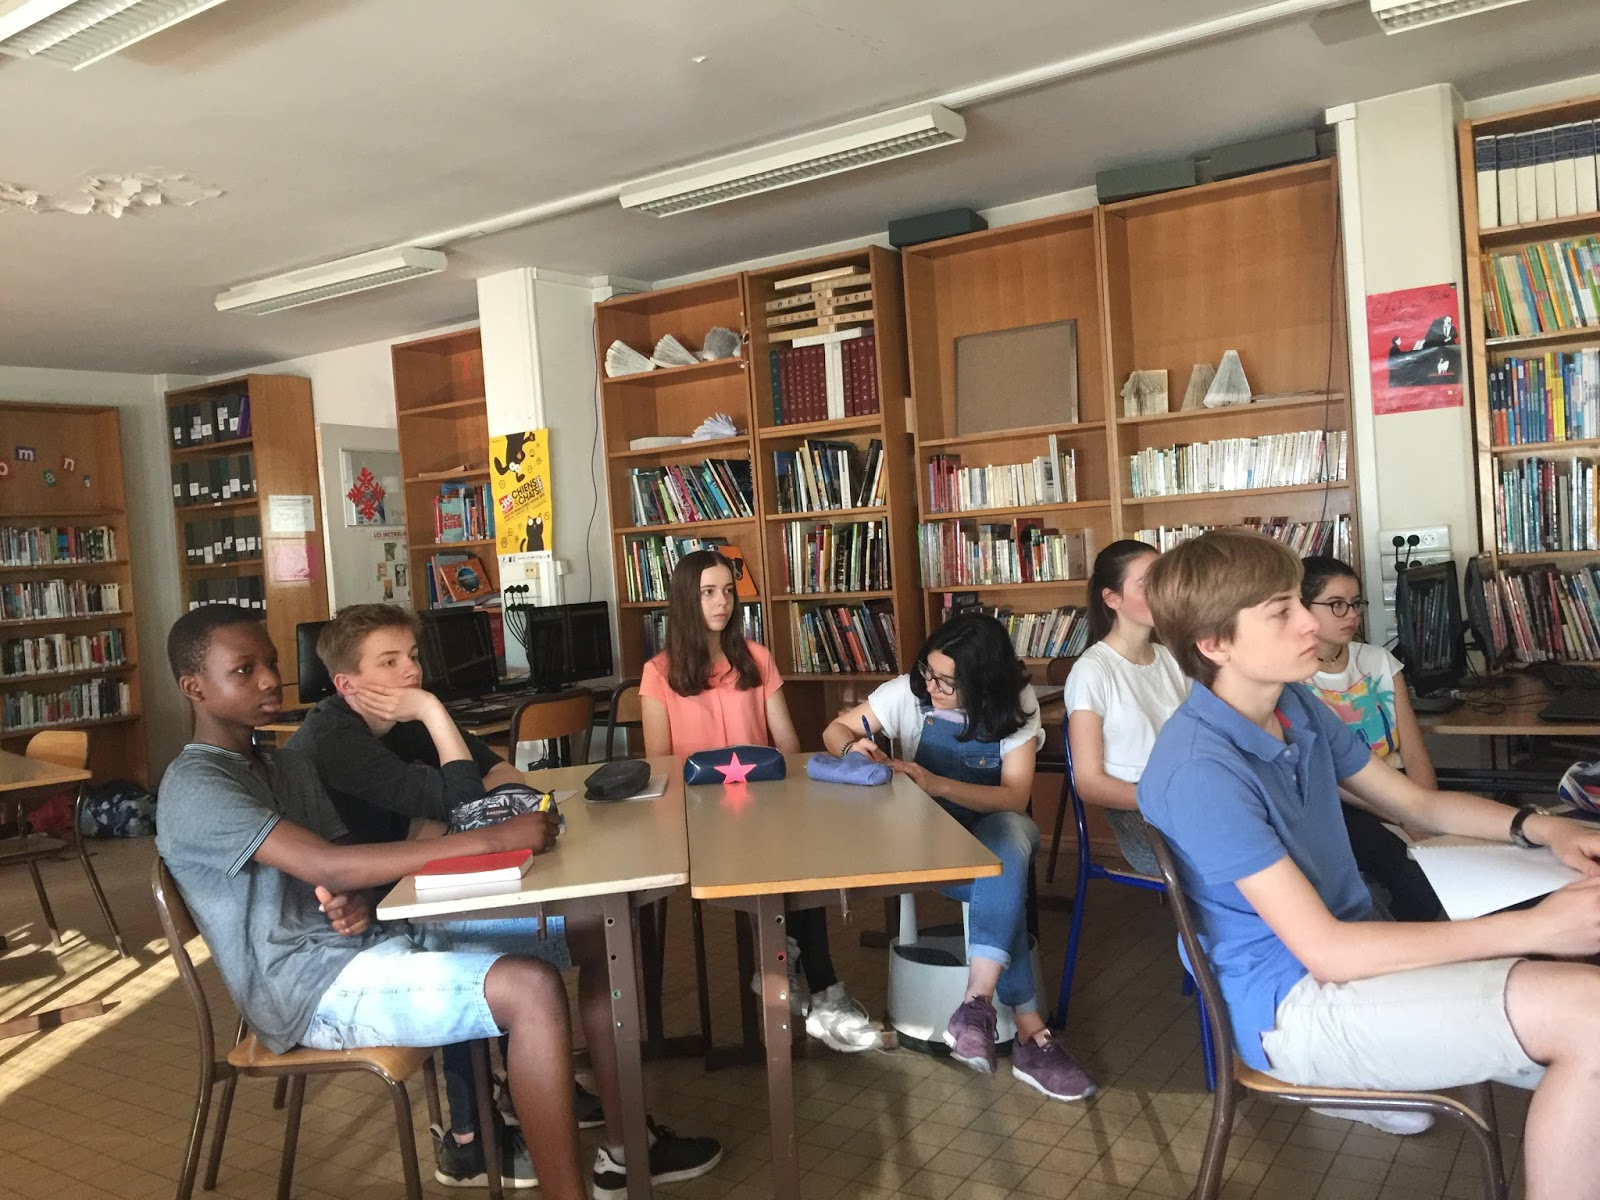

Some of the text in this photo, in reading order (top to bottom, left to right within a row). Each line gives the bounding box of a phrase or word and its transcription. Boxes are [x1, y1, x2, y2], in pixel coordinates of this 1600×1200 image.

[777, 292, 822, 308] DEGAS
[511, 478, 537, 499] CHIENS
[518, 486, 540, 505] CHATS
